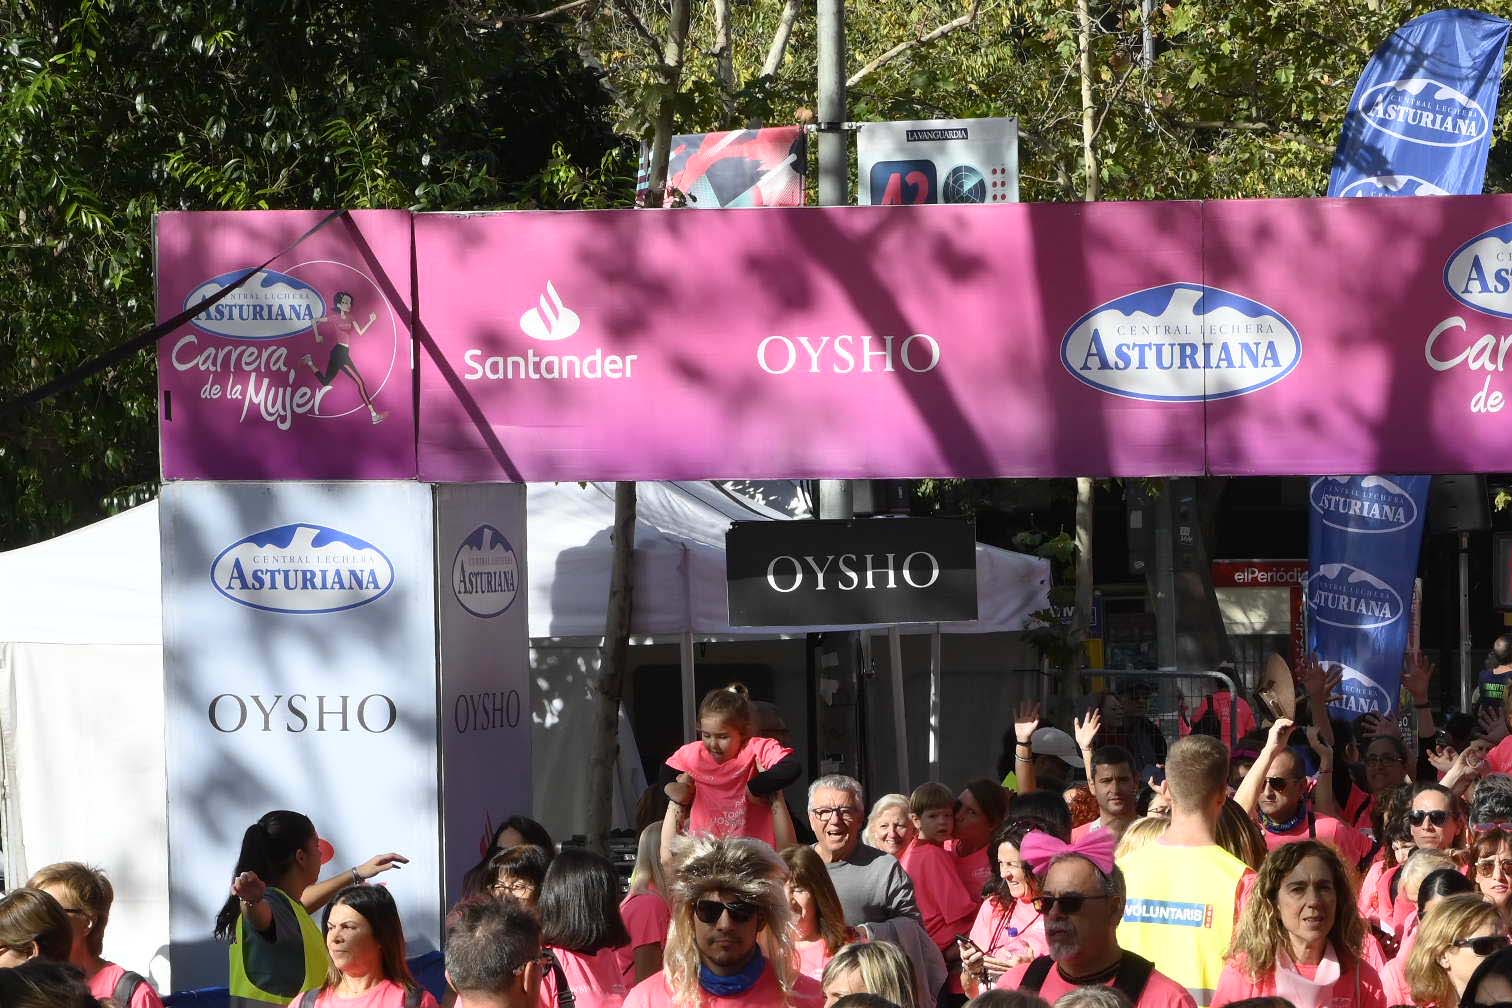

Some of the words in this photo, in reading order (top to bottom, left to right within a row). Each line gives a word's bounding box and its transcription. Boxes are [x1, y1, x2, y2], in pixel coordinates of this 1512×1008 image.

[1366, 92, 1478, 137] ASTURIANA
[1079, 327, 1282, 371] ASTURIANA
[1116, 324, 1192, 336] CENTRAL
[1200, 323, 1275, 335] LECHERA
[171, 333, 288, 373] Carrera
[464, 348, 638, 381] Santander
[757, 333, 941, 375] OYSHO
[200, 373, 222, 400] de
[226, 372, 243, 400] la
[239, 368, 334, 431] Mujer
[1470, 374, 1505, 414] de
[1318, 494, 1407, 524] ASTURIANA
[224, 556, 383, 592] ASTURIANA
[252, 554, 311, 565] CENTRAL
[316, 553, 376, 565] LECHERA
[456, 558, 516, 596] ASTURIANA
[765, 550, 940, 593] OYSHO
[1312, 590, 1393, 619] ASTURIANA
[207, 692, 398, 734] OYSHO
[453, 689, 521, 735] OYSHO
[1124, 903, 1204, 922] VOLUNTARIS
